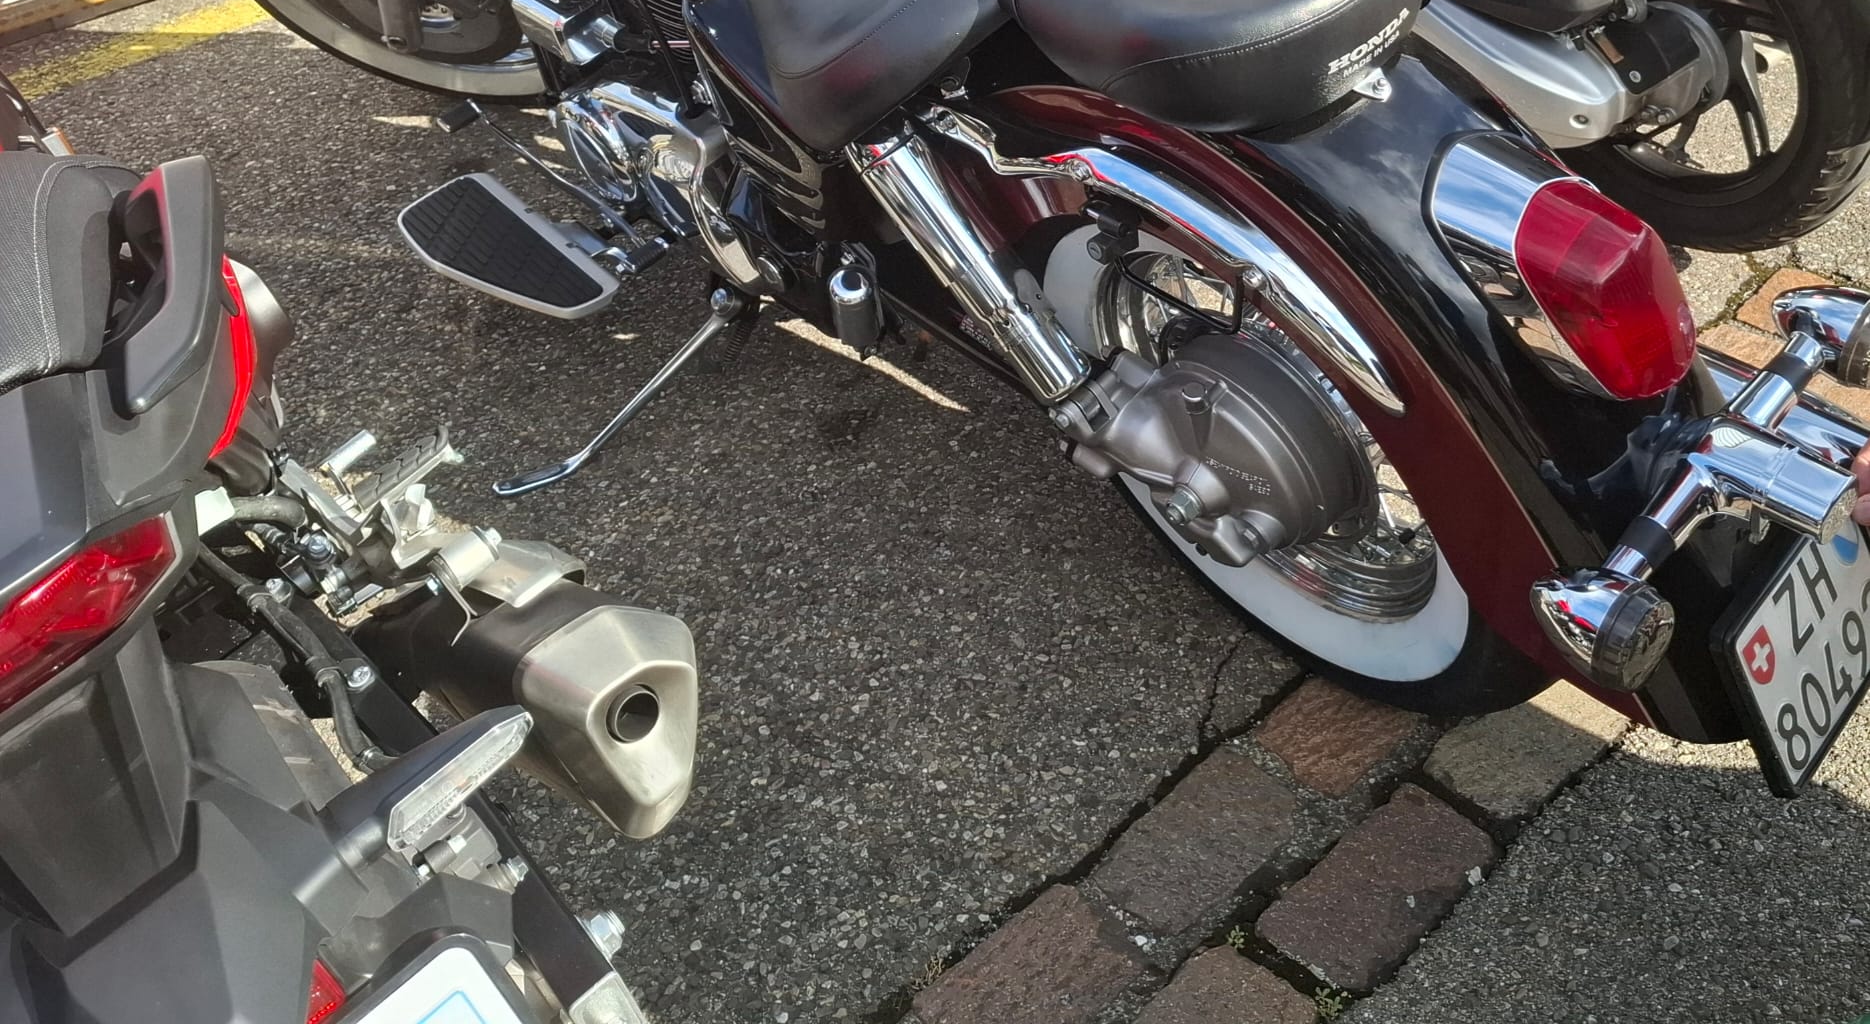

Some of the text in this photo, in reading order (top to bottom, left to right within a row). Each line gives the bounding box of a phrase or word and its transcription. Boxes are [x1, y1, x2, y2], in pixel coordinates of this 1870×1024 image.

[1327, 7, 1410, 75] HONDA
[1343, 53, 1373, 78] MADE
[1772, 540, 1838, 656] ZH
